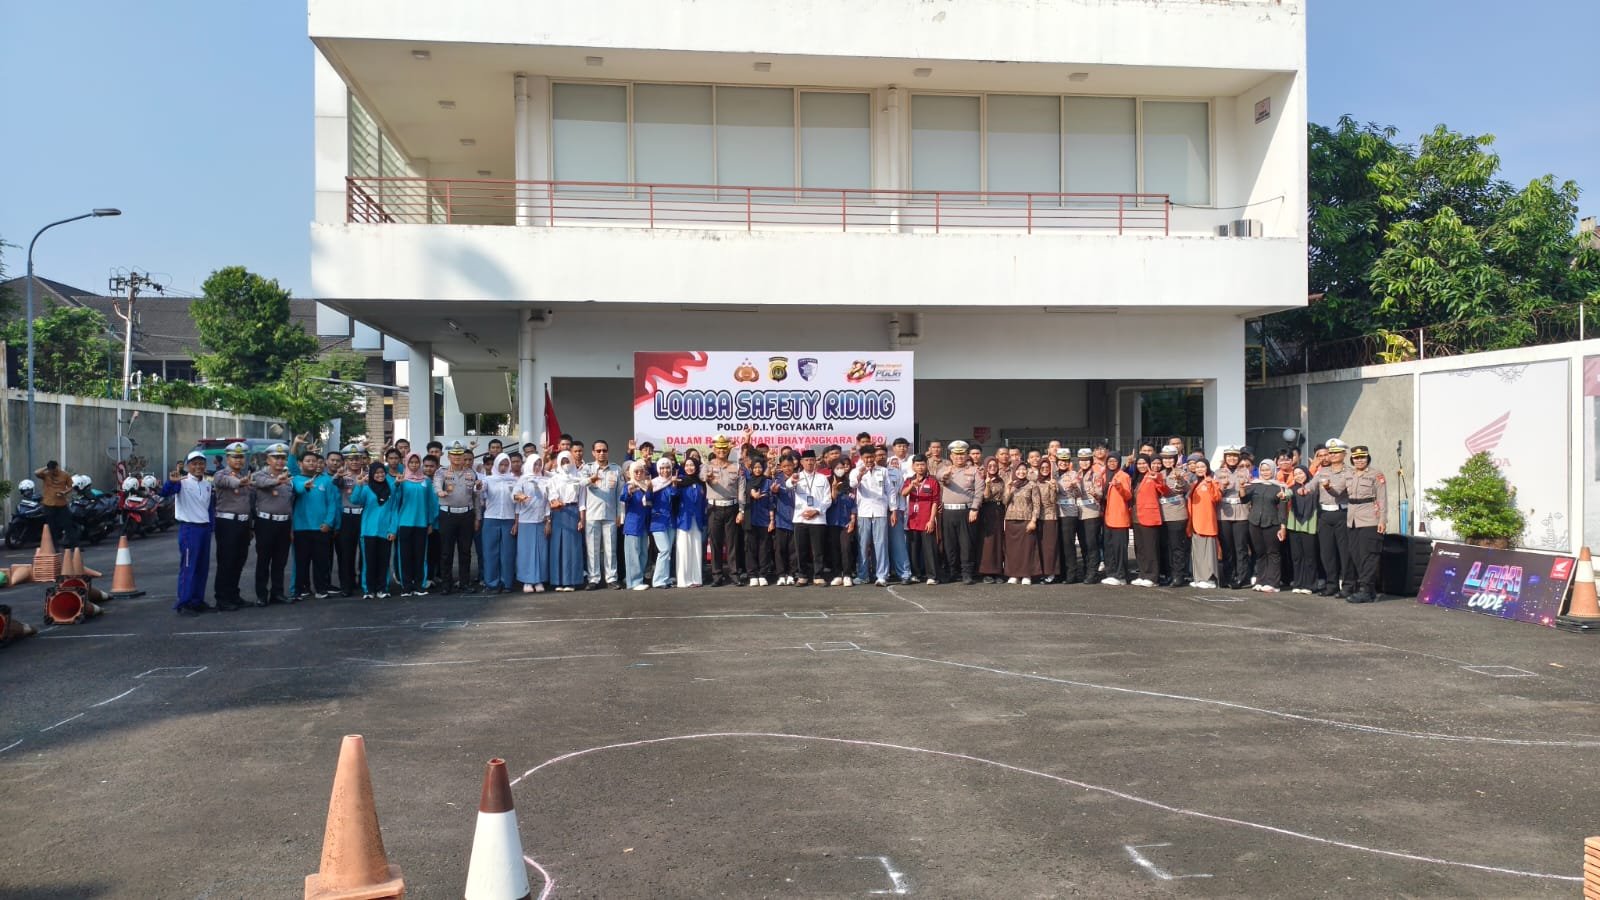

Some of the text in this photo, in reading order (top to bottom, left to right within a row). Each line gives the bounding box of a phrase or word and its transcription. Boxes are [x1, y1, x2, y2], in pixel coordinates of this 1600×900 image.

[655, 389, 895, 420] LOMBA SAFETY RIDING
[717, 422, 834, 431] POLDA D.I.YOGYAKARTA
[666, 436, 702, 444] DALAM
[751, 436, 775, 445] HARI
[777, 436, 853, 444] BHAYANGKARA
[1467, 592, 1506, 610] CODE
